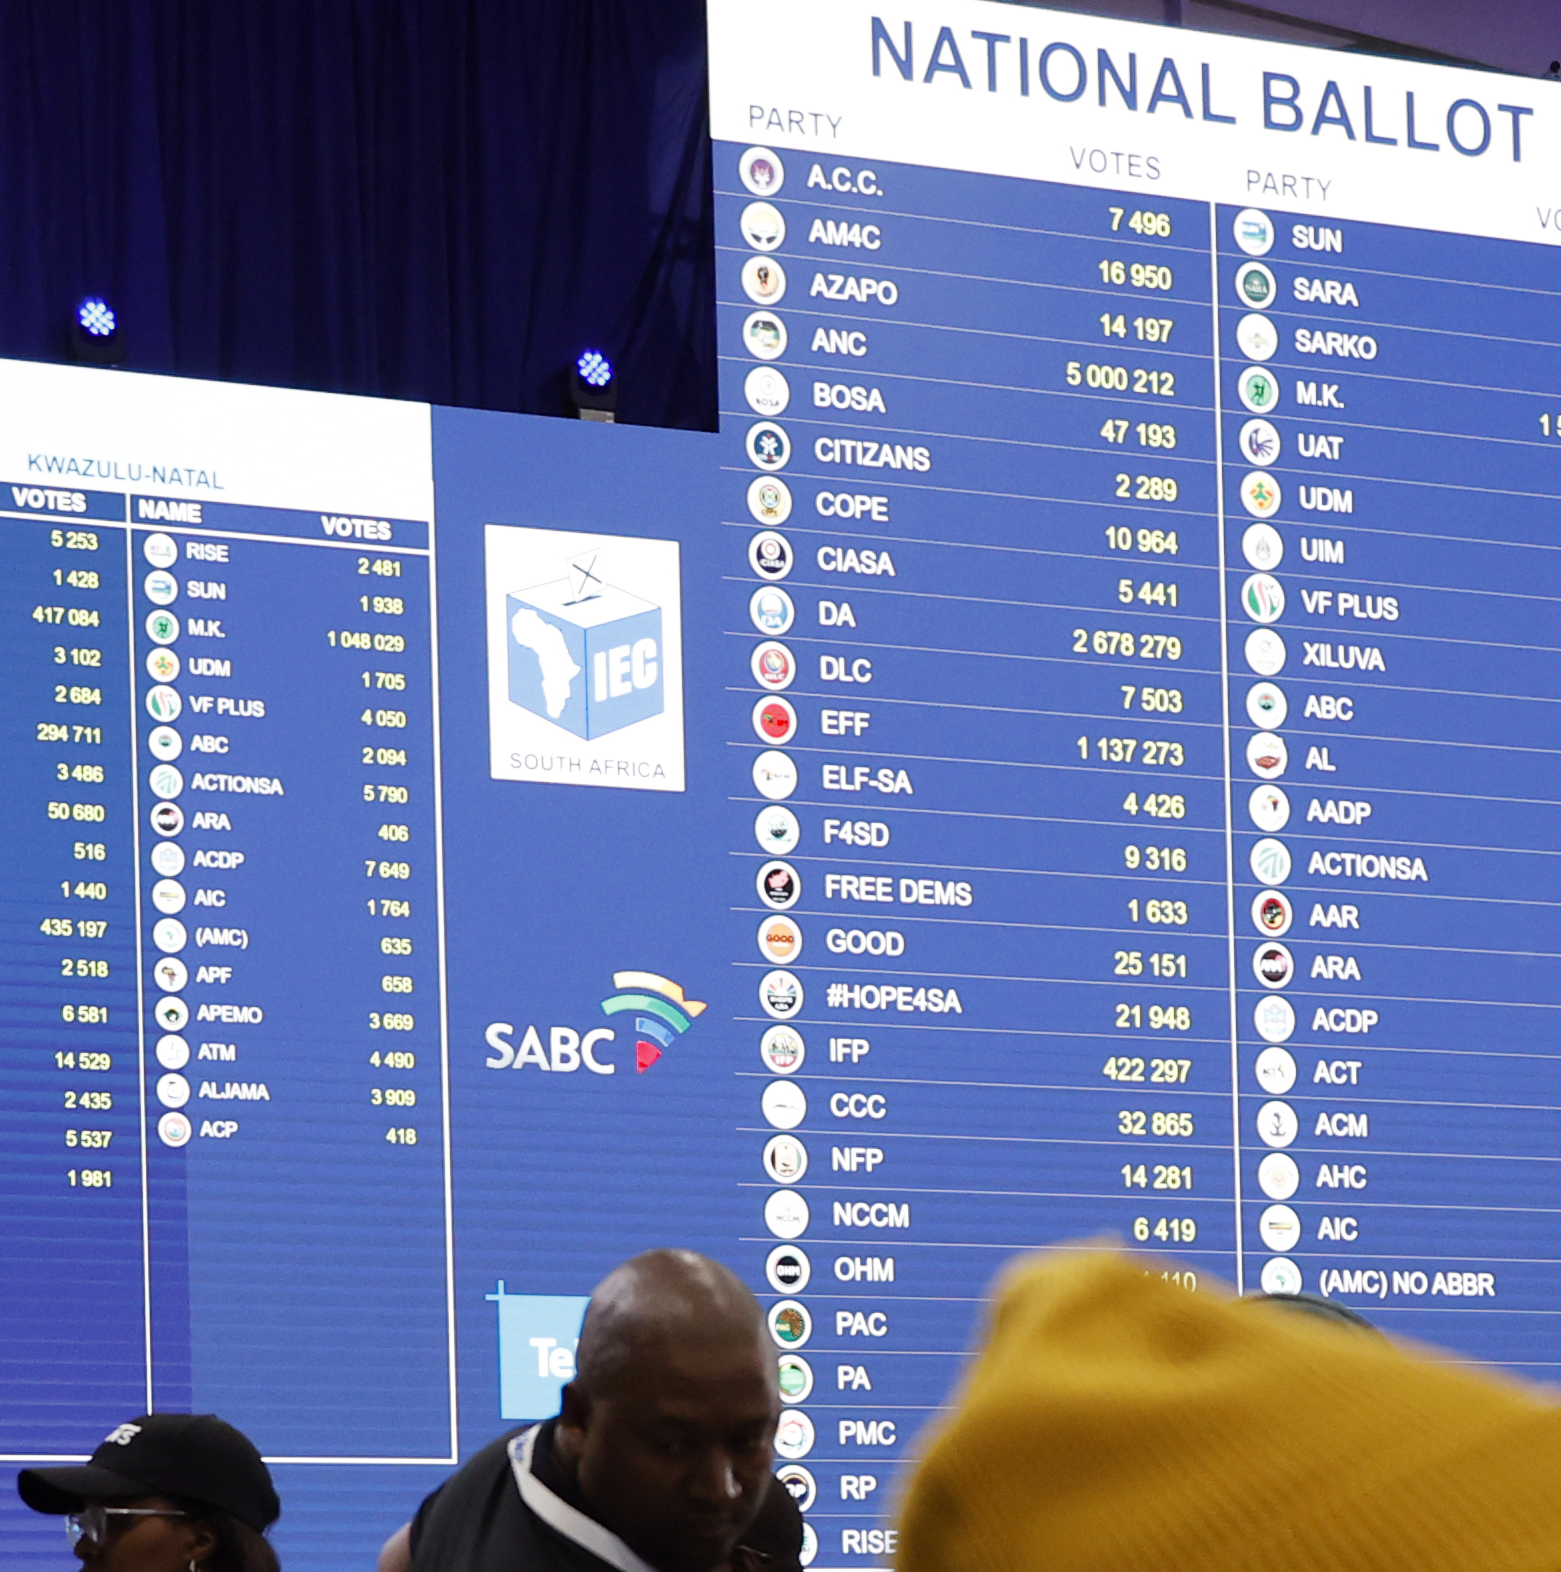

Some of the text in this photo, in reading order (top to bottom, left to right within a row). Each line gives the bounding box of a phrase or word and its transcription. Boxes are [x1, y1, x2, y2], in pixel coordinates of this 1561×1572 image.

[870, 15, 1537, 163] NATIONAL BALLOT
[750, 105, 841, 138] PARTY
[1070, 147, 1160, 180] VOTES
[807, 164, 883, 196] A.C.C.
[1247, 170, 1331, 201] PARTY
[808, 218, 881, 250] AM4C
[1290, 223, 1344, 254] SUN
[810, 273, 898, 305] AZAPO
[1293, 277, 1359, 307] SARA
[811, 327, 867, 357] ANC
[1295, 328, 1377, 360] SARKO
[1066, 362, 1175, 395] 5 000 212
[813, 382, 886, 413] BOSA
[1296, 380, 1345, 409] M.K.
[1540, 413, 1549, 436] 1
[814, 437, 931, 472] CITIZANS
[1298, 433, 1344, 460] UAT
[27, 455, 224, 489] KWAZULU-NATAL
[12, 487, 87, 512] VOTES
[816, 491, 889, 522] COPE
[1299, 485, 1353, 513] UDM
[815, 546, 896, 578] CIASA
[1301, 537, 1344, 564] UIM
[819, 600, 856, 628] DA
[1302, 589, 1399, 621] VF PLUS
[1073, 629, 1181, 659] 2 678 279
[1303, 642, 1386, 672] XILUVA
[595, 639, 657, 701] IEC
[820, 655, 872, 683] DLC
[1304, 694, 1354, 721] ABC
[821, 709, 870, 736] EFF
[511, 753, 665, 778] SOUTH AFRICA
[1305, 746, 1336, 771] AL
[823, 764, 913, 794] ELF-SA
[1306, 799, 1371, 825] AADP
[379, 825, 408, 842] 406
[824, 819, 889, 847] F4SD
[74, 842, 105, 860] 516
[1308, 851, 1428, 881] ACTIONSA
[826, 875, 973, 907] FREE DEMS
[1309, 903, 1360, 929] AAR
[826, 928, 905, 956] GOOD
[1310, 955, 1361, 981] ARA
[826, 983, 963, 1014] #HOPE4SA
[197, 1005, 262, 1023] APEMO
[1312, 1007, 1378, 1033] ACDP
[486, 1023, 614, 1074] SABC
[830, 1038, 870, 1063] IFP
[1313, 1060, 1362, 1085] ACT
[830, 1092, 886, 1119] CCC
[1315, 1112, 1368, 1137] ACM
[832, 1146, 884, 1172] NFP
[1316, 1164, 1367, 1189] AHC
[833, 1201, 910, 1228] NCCM
[1317, 1216, 1358, 1241] AIC
[834, 1256, 894, 1282] OHM
[1319, 1269, 1495, 1299] (AMC) NO ABBR
[836, 1311, 887, 1337] PAC
[529, 1338, 578, 1377] Te
[837, 1365, 871, 1390] PA
[839, 1420, 896, 1445] PMC
[840, 1475, 877, 1500] RP
[842, 1529, 899, 1555] RISE
